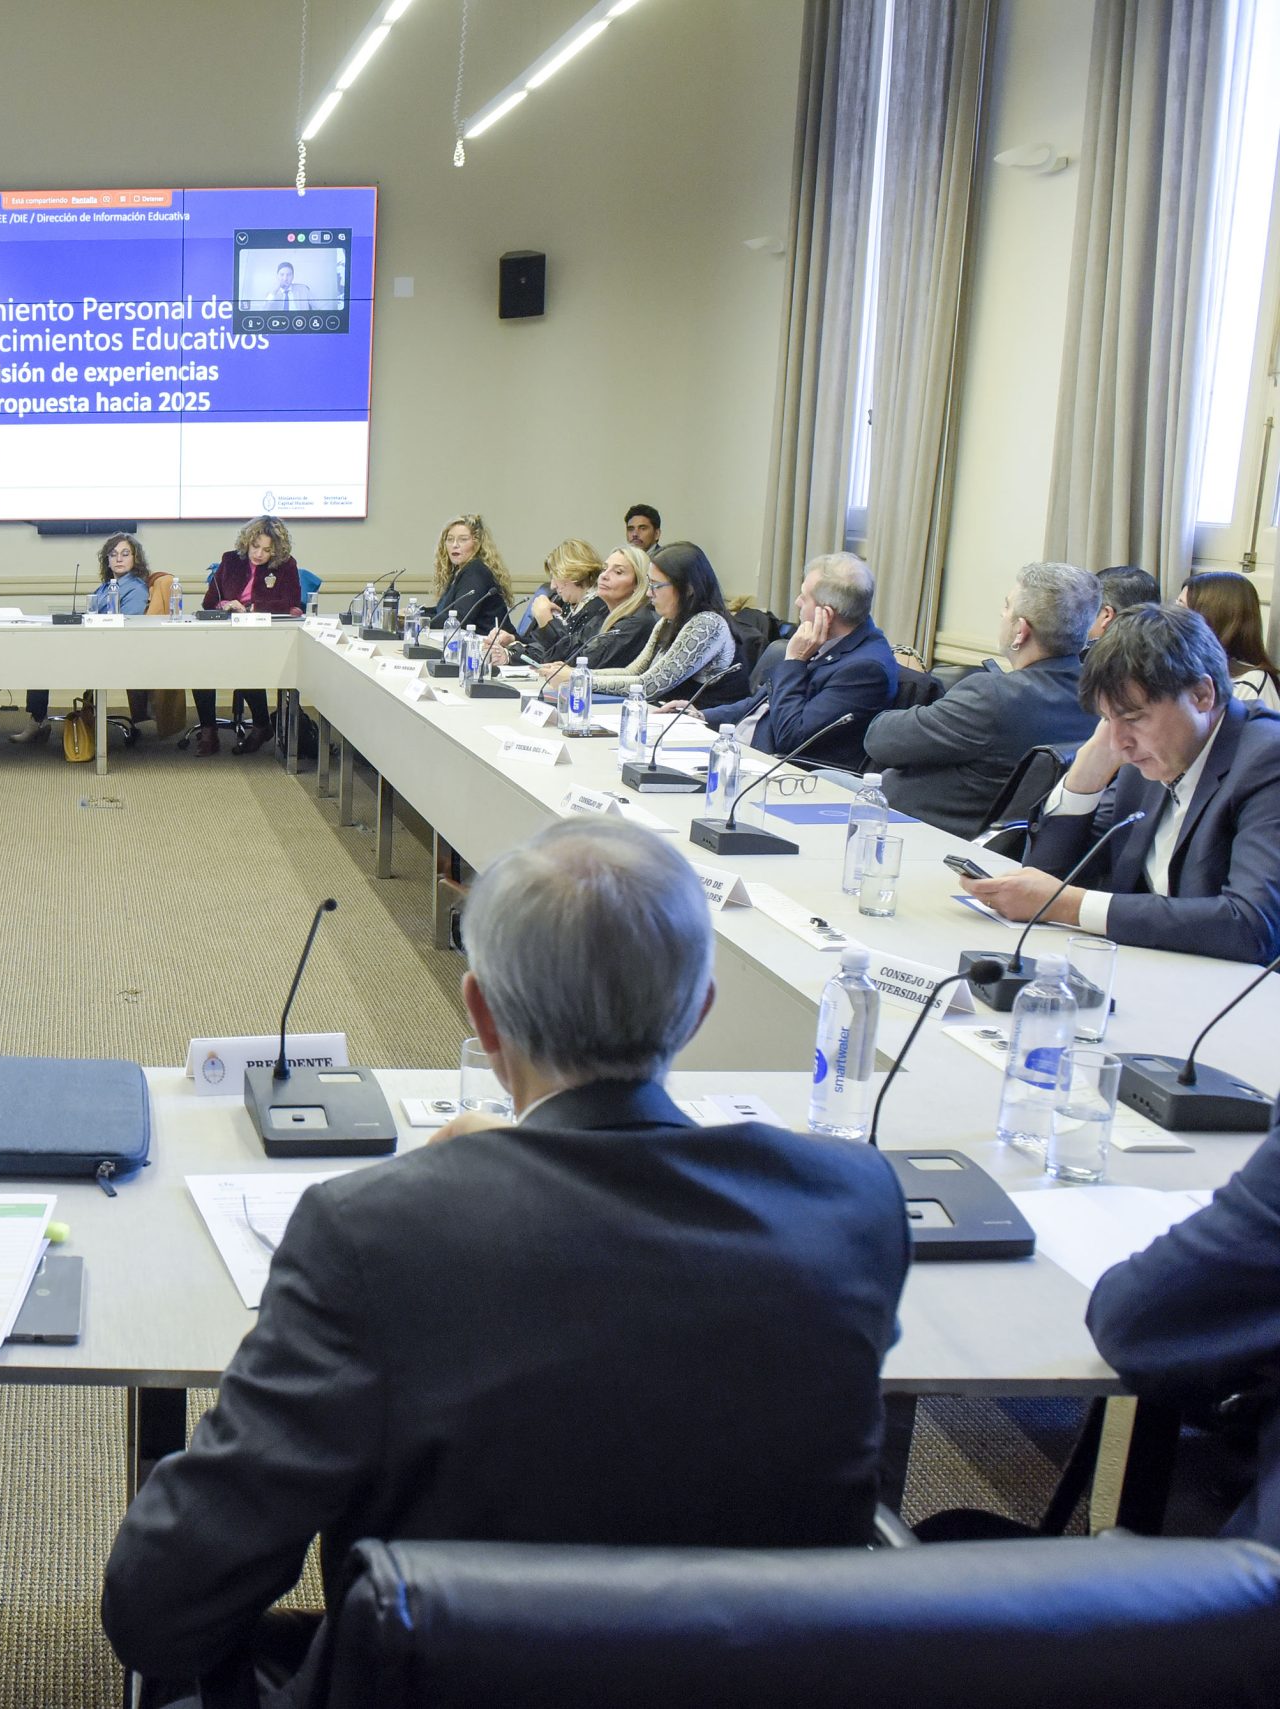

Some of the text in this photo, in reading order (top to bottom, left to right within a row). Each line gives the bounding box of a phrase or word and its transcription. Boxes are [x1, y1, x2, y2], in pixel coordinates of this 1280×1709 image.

[36, 212, 79, 223] Dirección
[80, 213, 91, 222] de
[93, 212, 146, 222] Información
[148, 212, 190, 221] Educativa
[83, 294, 193, 321] Personal
[201, 294, 233, 319] de
[132, 325, 270, 351] Educativos
[51, 362, 78, 383] de
[84, 361, 219, 387] experiencias
[96, 392, 152, 413] hacia
[158, 391, 211, 412] 2025
[880, 966, 925, 987] CONSEJO
[834, 1026, 850, 1094] smartwater
